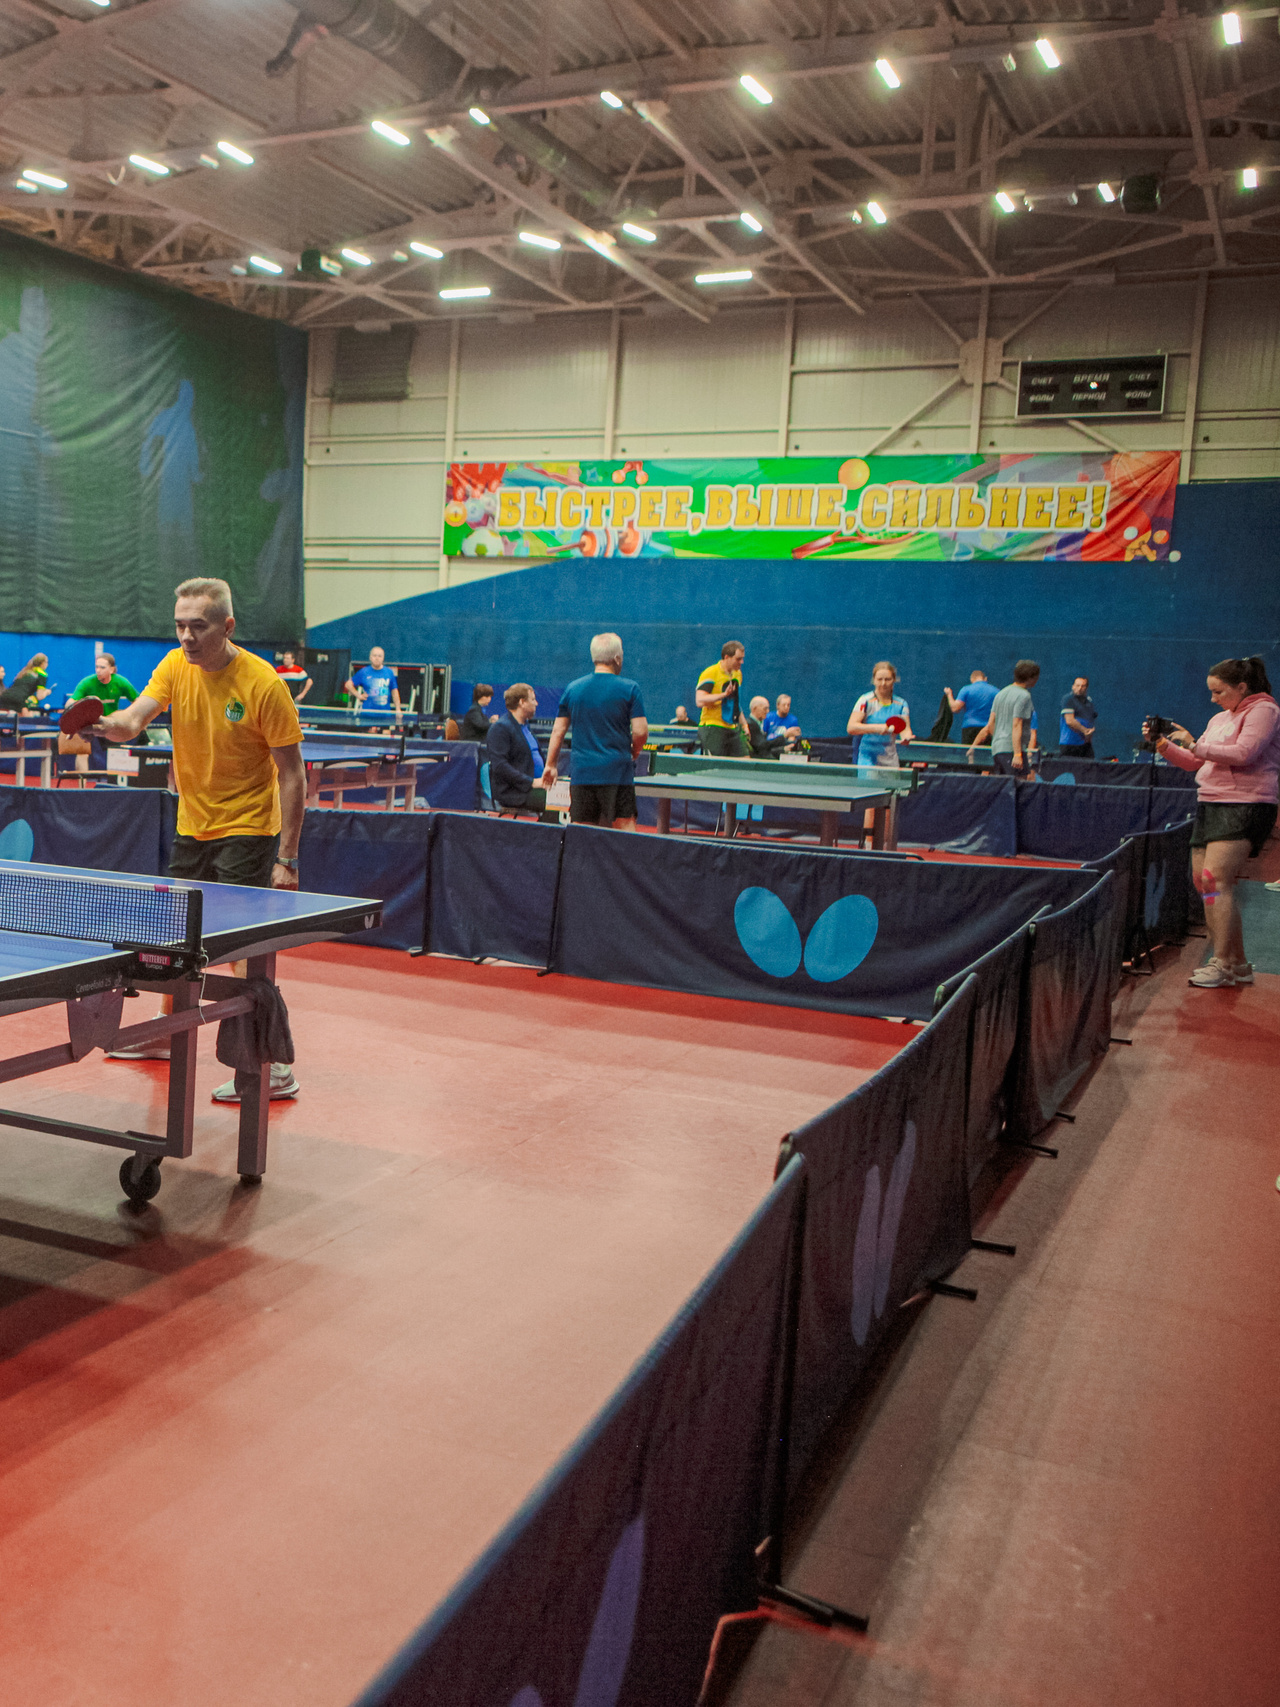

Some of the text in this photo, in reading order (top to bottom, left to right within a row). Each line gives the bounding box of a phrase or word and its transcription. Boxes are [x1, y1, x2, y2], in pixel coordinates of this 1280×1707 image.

[1073, 372, 1110, 383] ВРЕМЯ
[1072, 392, 1107, 401] ПЕРИОД
[141, 953, 169, 965] BUTTERFLY
